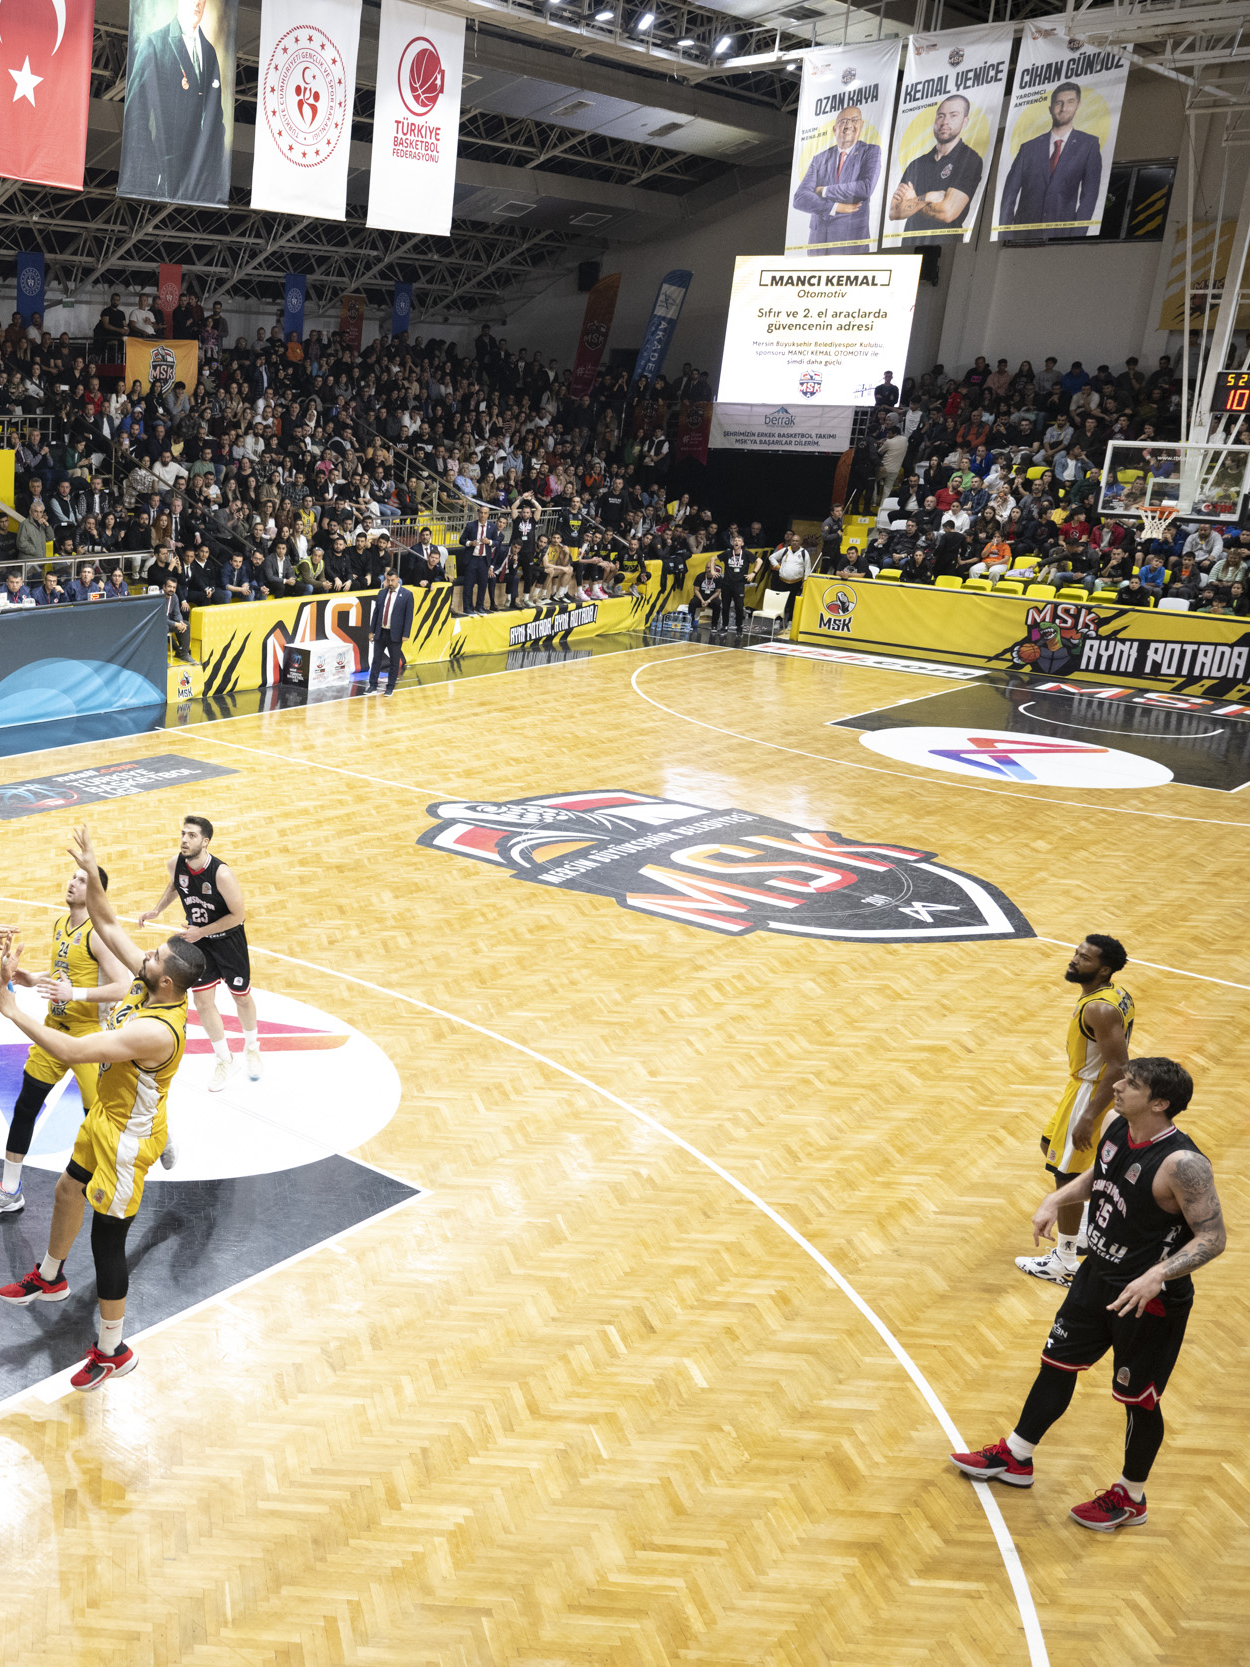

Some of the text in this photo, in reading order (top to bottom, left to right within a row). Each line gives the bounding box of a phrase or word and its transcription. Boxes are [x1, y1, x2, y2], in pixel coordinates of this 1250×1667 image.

[903, 60, 1006, 104] KEMAL YENİCE
[1019, 60, 1064, 90] CİHAN
[815, 83, 880, 117] OZAN KAYA
[1013, 96, 1048, 108] ANTRENÖR
[1015, 89, 1047, 100] YARDIMCI
[394, 116, 441, 141] TÜRKİYE
[393, 136, 440, 153] BASKETBOL
[392, 148, 440, 163] FEDERASYONU
[770, 275, 878, 287] MANCI KEMAL
[797, 289, 847, 299] Otomotiv
[757, 308, 888, 320] Sıfır ve 2. el araçlarda
[766, 321, 874, 333] güvencenin adresi
[152, 365, 173, 379] MSK
[799, 382, 822, 393] MSK
[764, 415, 796, 426] berrak
[1215, 504, 1234, 513] TBF
[818, 612, 853, 633] MSK
[1027, 604, 1099, 631] MSK
[510, 626, 526, 646] AYNI
[554, 612, 569, 632] AYNI
[759, 644, 977, 677] misli.com
[1080, 639, 1140, 673] AYNI
[177, 686, 193, 698] MSK
[52, 763, 139, 783] misli.com
[66, 768, 155, 788] TÜRKİYE
[82, 768, 203, 794] BASKETBOL
[537, 811, 759, 884] MERSİN BÜYÜKŞEHİR BELEDİYESİ
[626, 832, 927, 934] MSK
[191, 907, 209, 923] 23
[57, 941, 70, 959] 24
[50, 1005, 68, 1016] MSK
